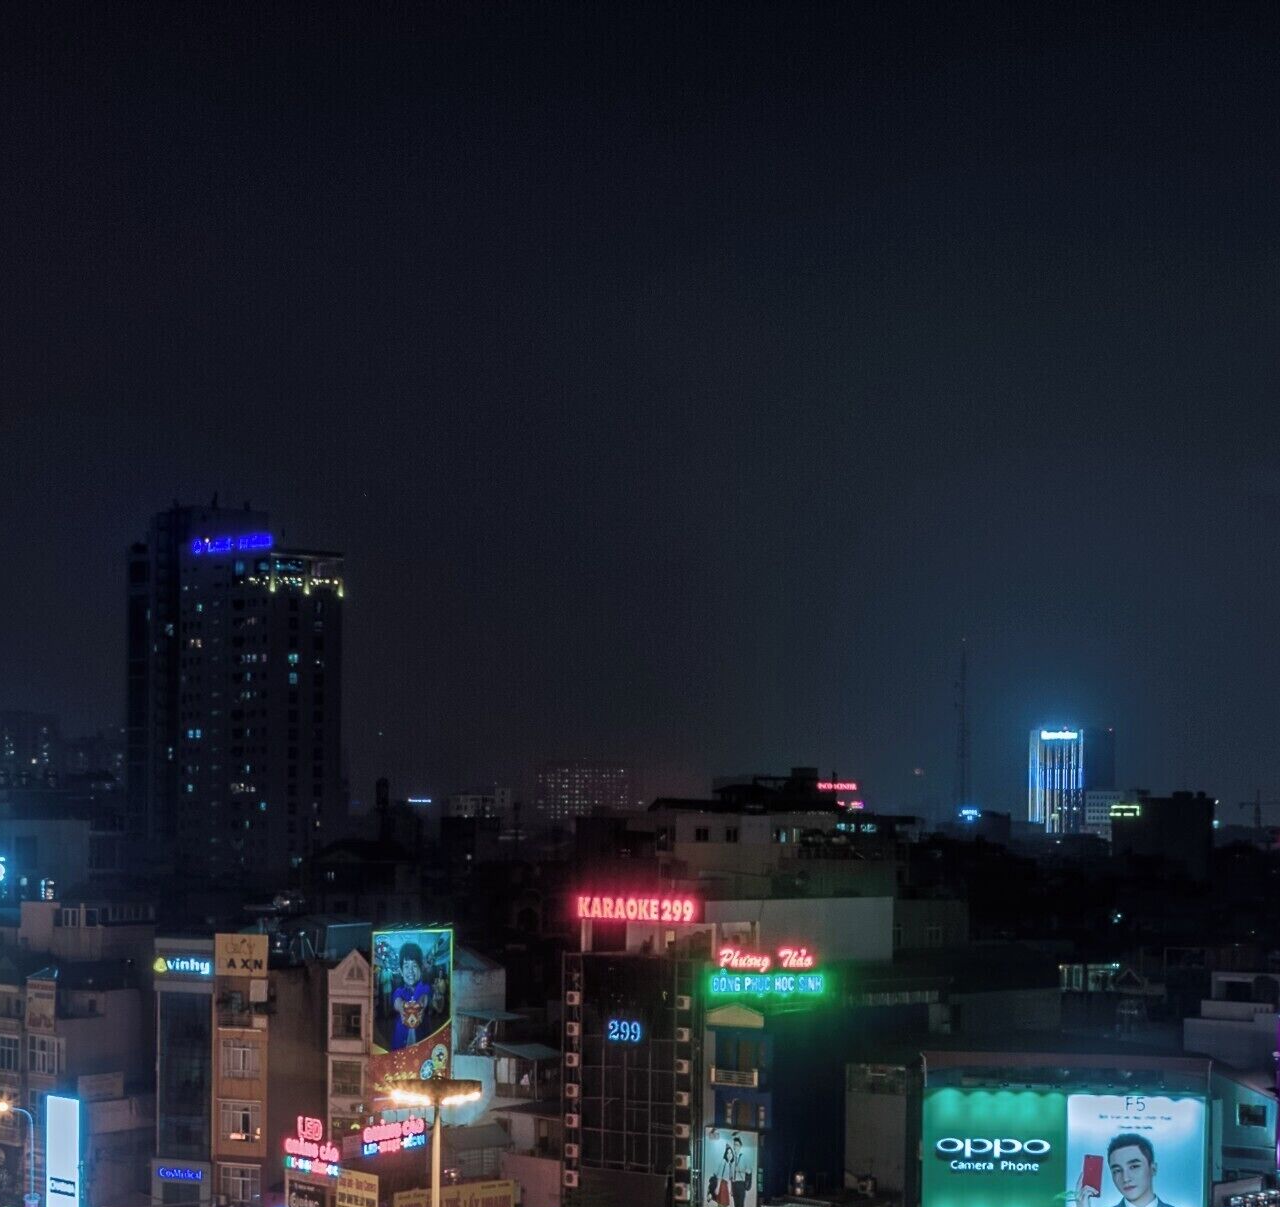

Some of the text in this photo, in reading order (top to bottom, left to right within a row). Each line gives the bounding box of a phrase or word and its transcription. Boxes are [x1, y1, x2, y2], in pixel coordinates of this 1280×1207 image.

[578, 896, 694, 921] KARAOKE 299
[798, 976, 823, 992] SINH
[608, 1020, 641, 1041] 299
[1125, 1096, 1146, 1112] F5
[297, 1116, 322, 1141] LED
[950, 1160, 1040, 1172] Camera Phone
